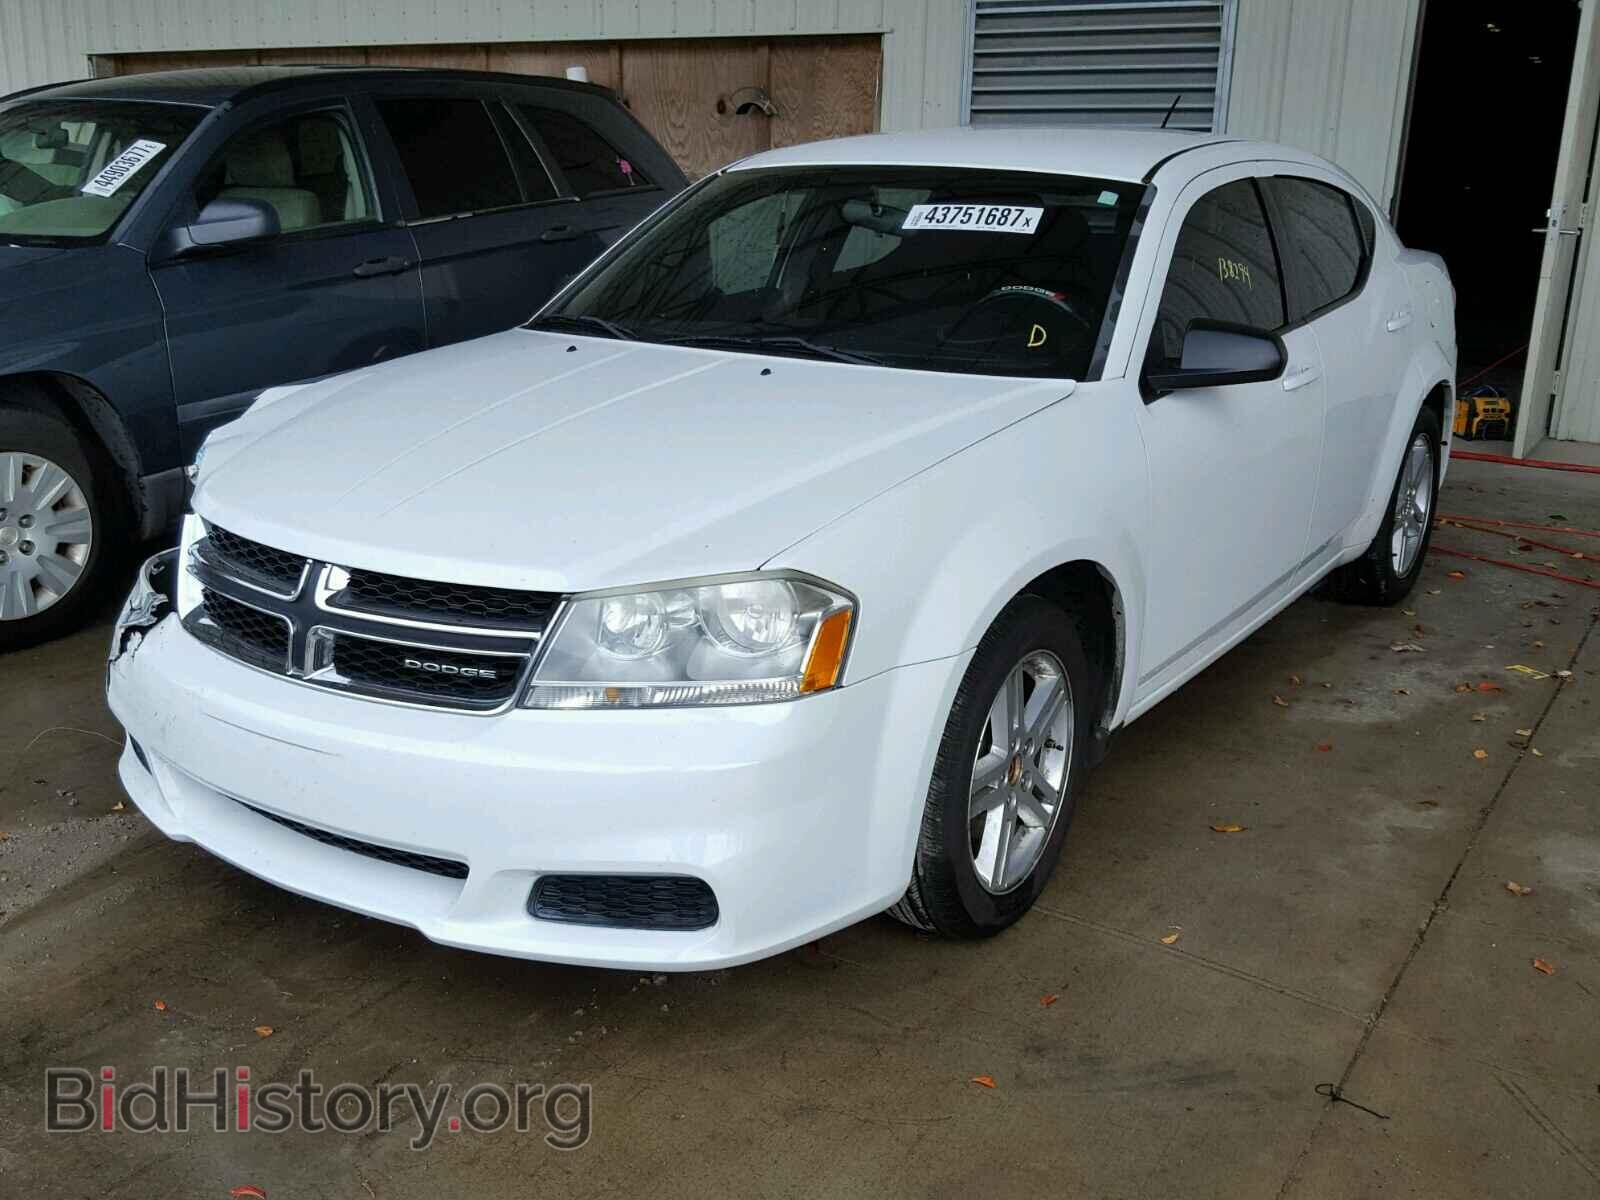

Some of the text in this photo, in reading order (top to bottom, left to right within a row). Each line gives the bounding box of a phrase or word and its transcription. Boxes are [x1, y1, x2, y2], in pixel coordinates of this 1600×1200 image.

[94, 145, 151, 187] 44903677
[924, 206, 1025, 227] 43751687
[1027, 324, 1047, 347] D
[404, 659, 497, 679] DODGE
